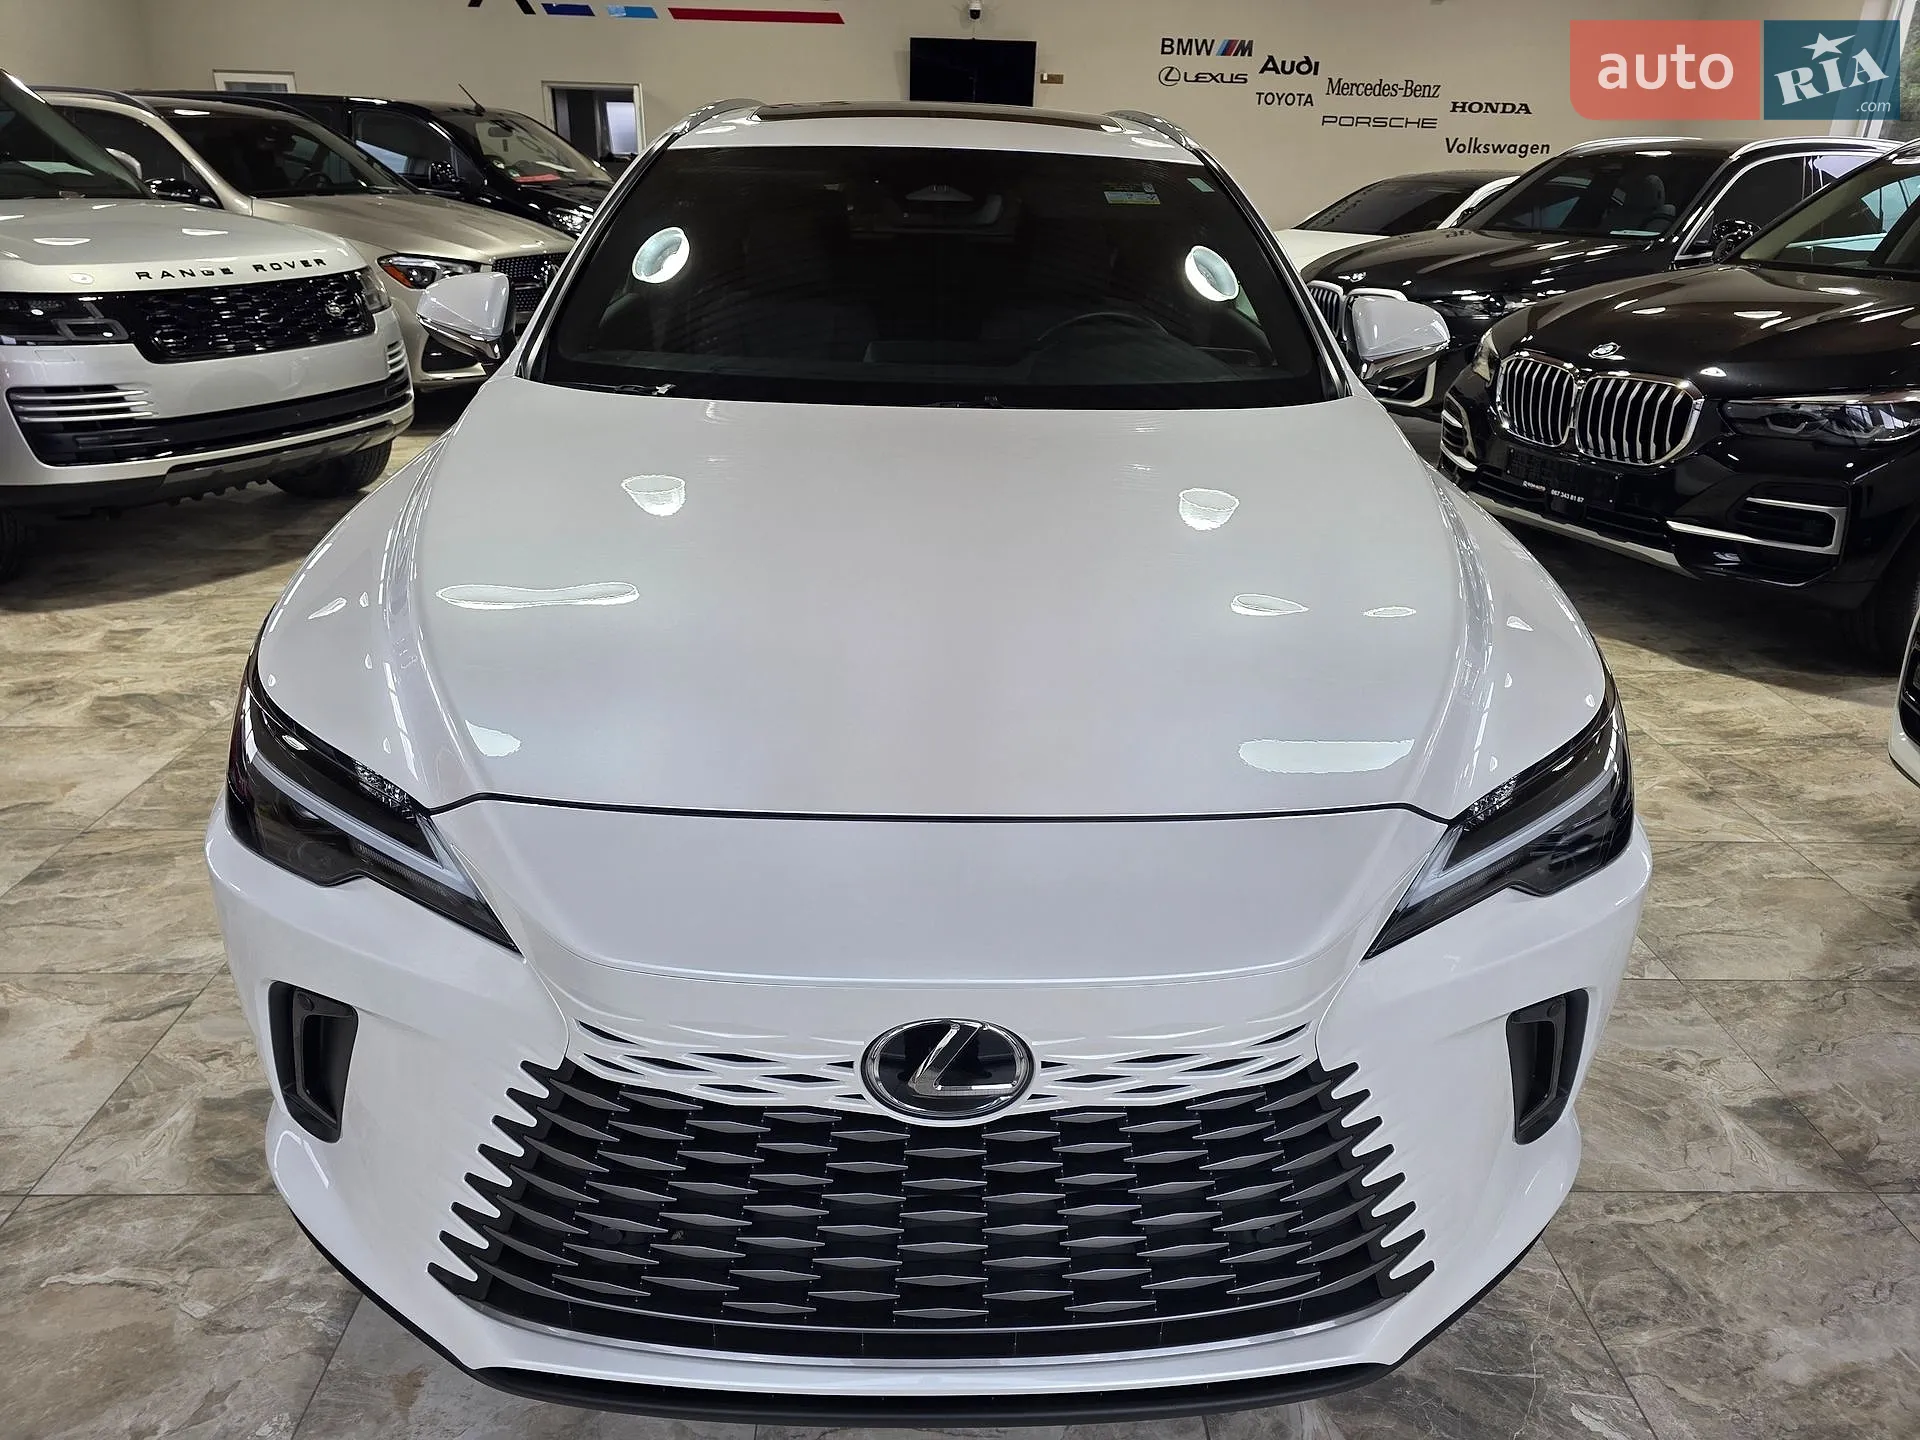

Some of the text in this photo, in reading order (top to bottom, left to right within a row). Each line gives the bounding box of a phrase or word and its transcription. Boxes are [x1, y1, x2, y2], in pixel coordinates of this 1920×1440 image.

[1160, 37, 1216, 56] BMW
[1258, 55, 1320, 76] Audi
[1183, 71, 1249, 84] LEXUS
[1325, 77, 1441, 99] Mercedes-Benz
[1255, 91, 1315, 107] TOYOTA
[1449, 101, 1533, 115] HONDA
[1321, 115, 1438, 129] PORSCHE
[1444, 136, 1551, 159] Volkswagen
[135, 258, 328, 281] RANGE ROVER
